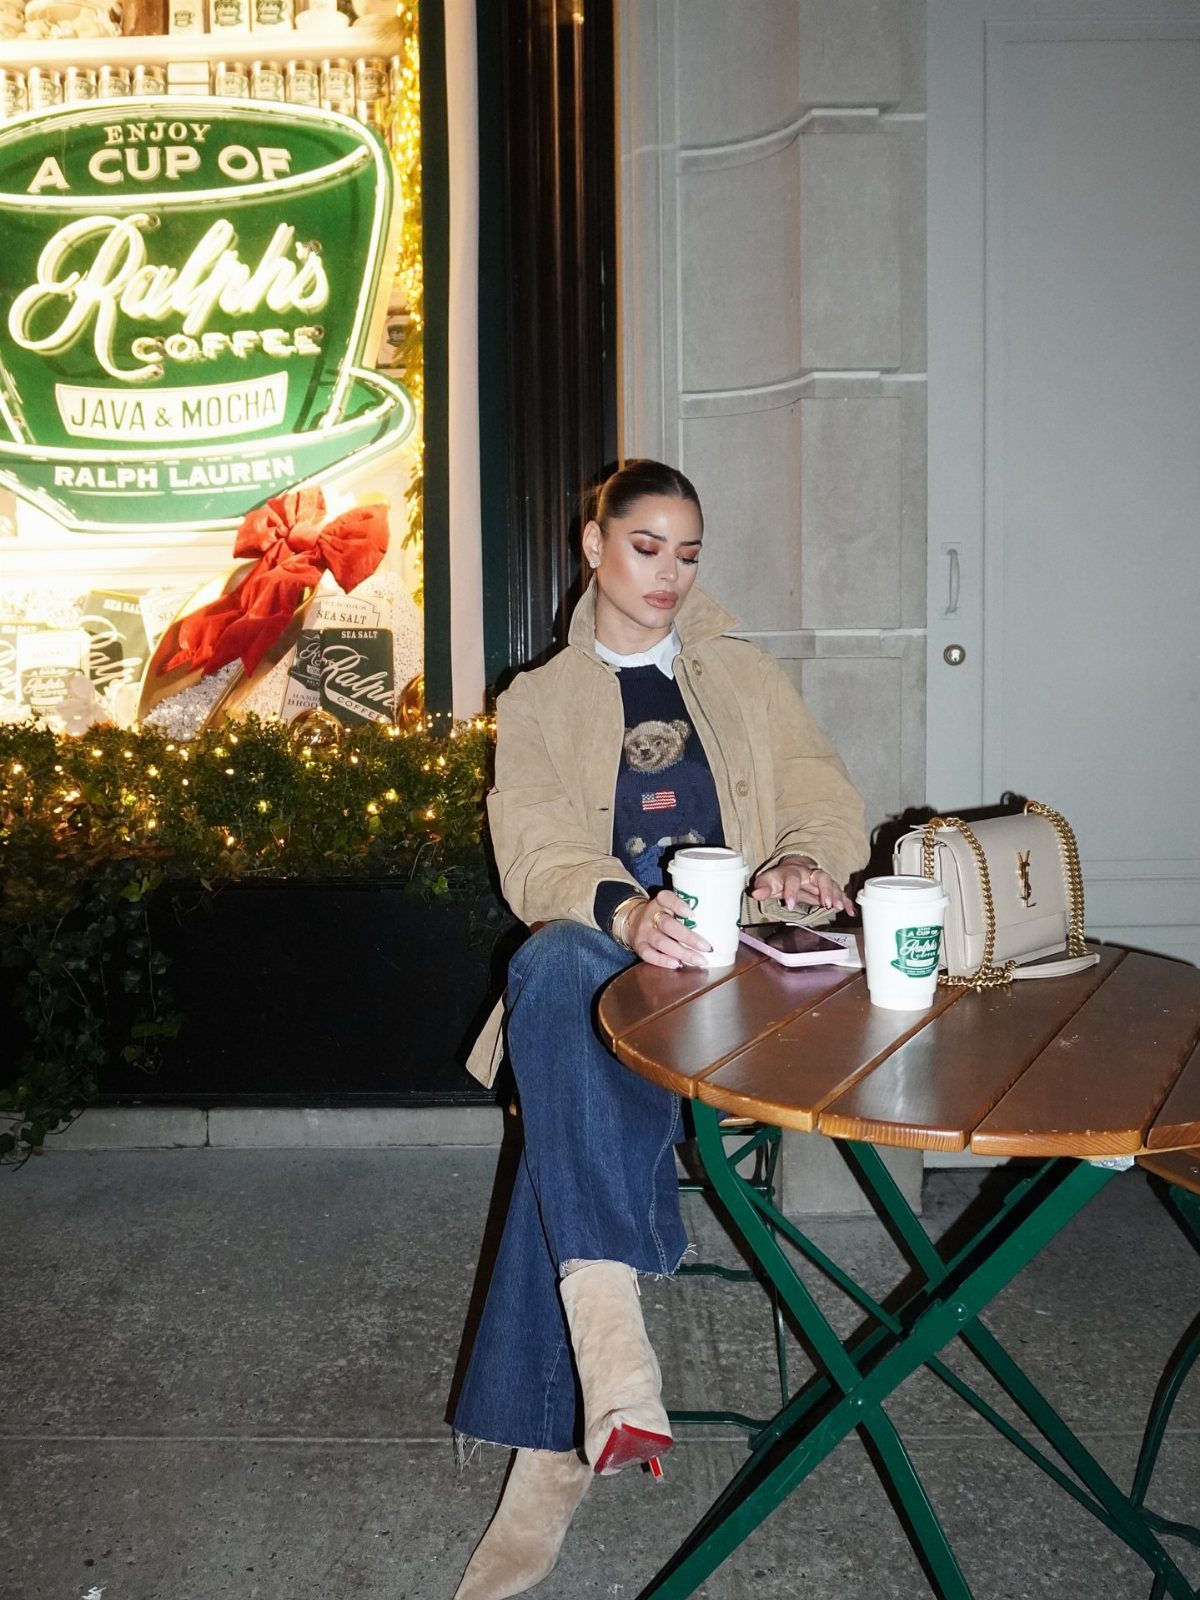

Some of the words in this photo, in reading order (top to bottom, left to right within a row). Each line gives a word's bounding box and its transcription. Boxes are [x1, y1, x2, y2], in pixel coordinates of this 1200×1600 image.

[104, 121, 212, 146] ENJOY
[27, 157, 71, 194] A
[88, 145, 201, 185] CUP
[217, 144, 293, 181] OF
[8, 213, 331, 383] Ralph's
[131, 325, 325, 363] COFFEE
[71, 397, 145, 431] JAVA
[155, 406, 176, 427] &
[181, 385, 278, 427] MOCHA
[55, 465, 158, 489] RALPH
[169, 456, 295, 488] LAUREN
[316, 609, 337, 621] SEA
[339, 612, 367, 625] SALT
[341, 630, 357, 639] SEA
[358, 631, 378, 639] SALT
